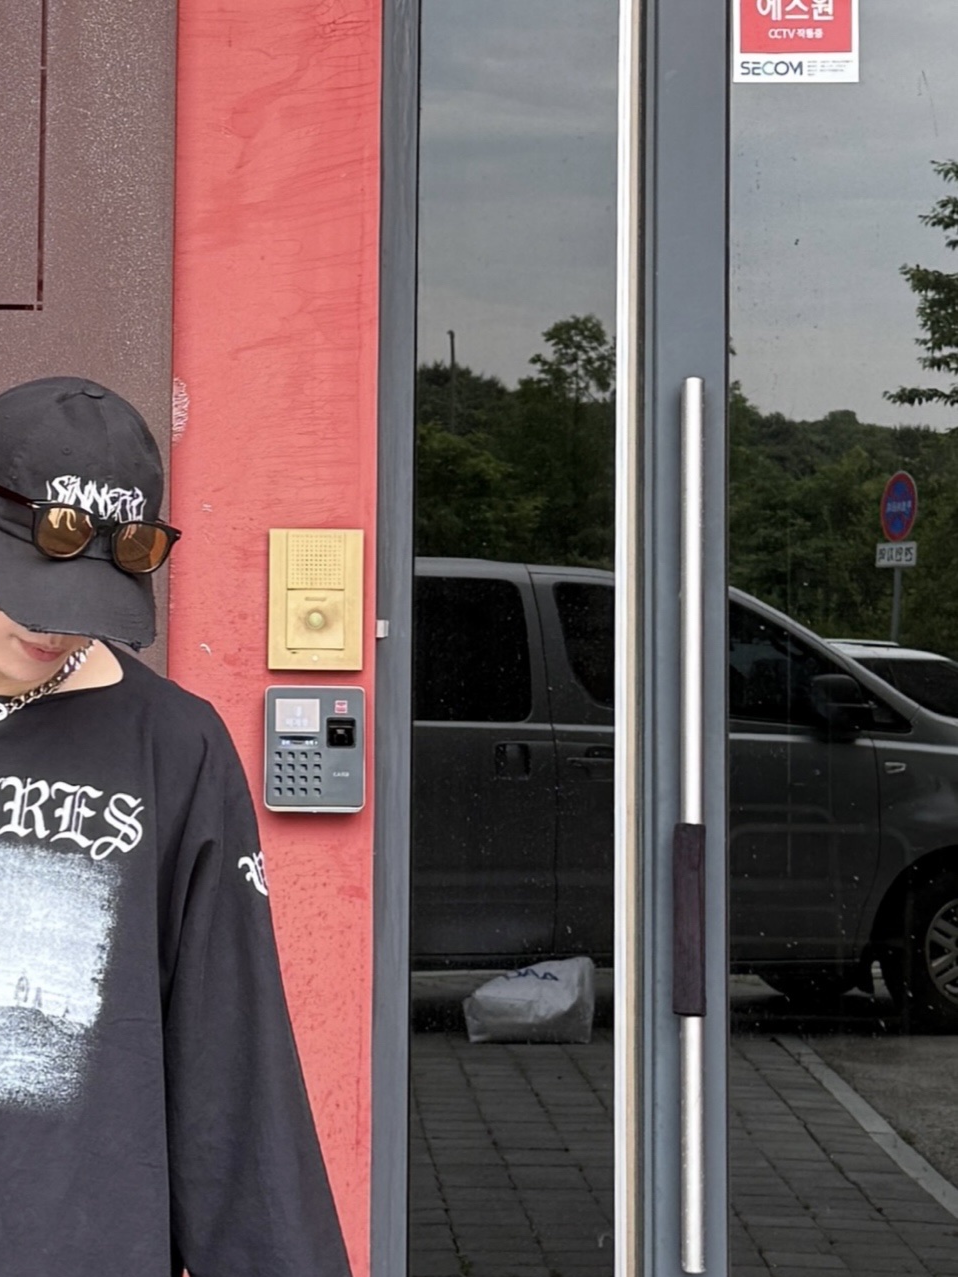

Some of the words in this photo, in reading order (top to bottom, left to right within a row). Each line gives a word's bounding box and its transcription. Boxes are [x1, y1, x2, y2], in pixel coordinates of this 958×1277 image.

[756, 0, 835, 21] 에스원
[768, 28, 795, 39] CCTV
[740, 60, 804, 76] SECOM
